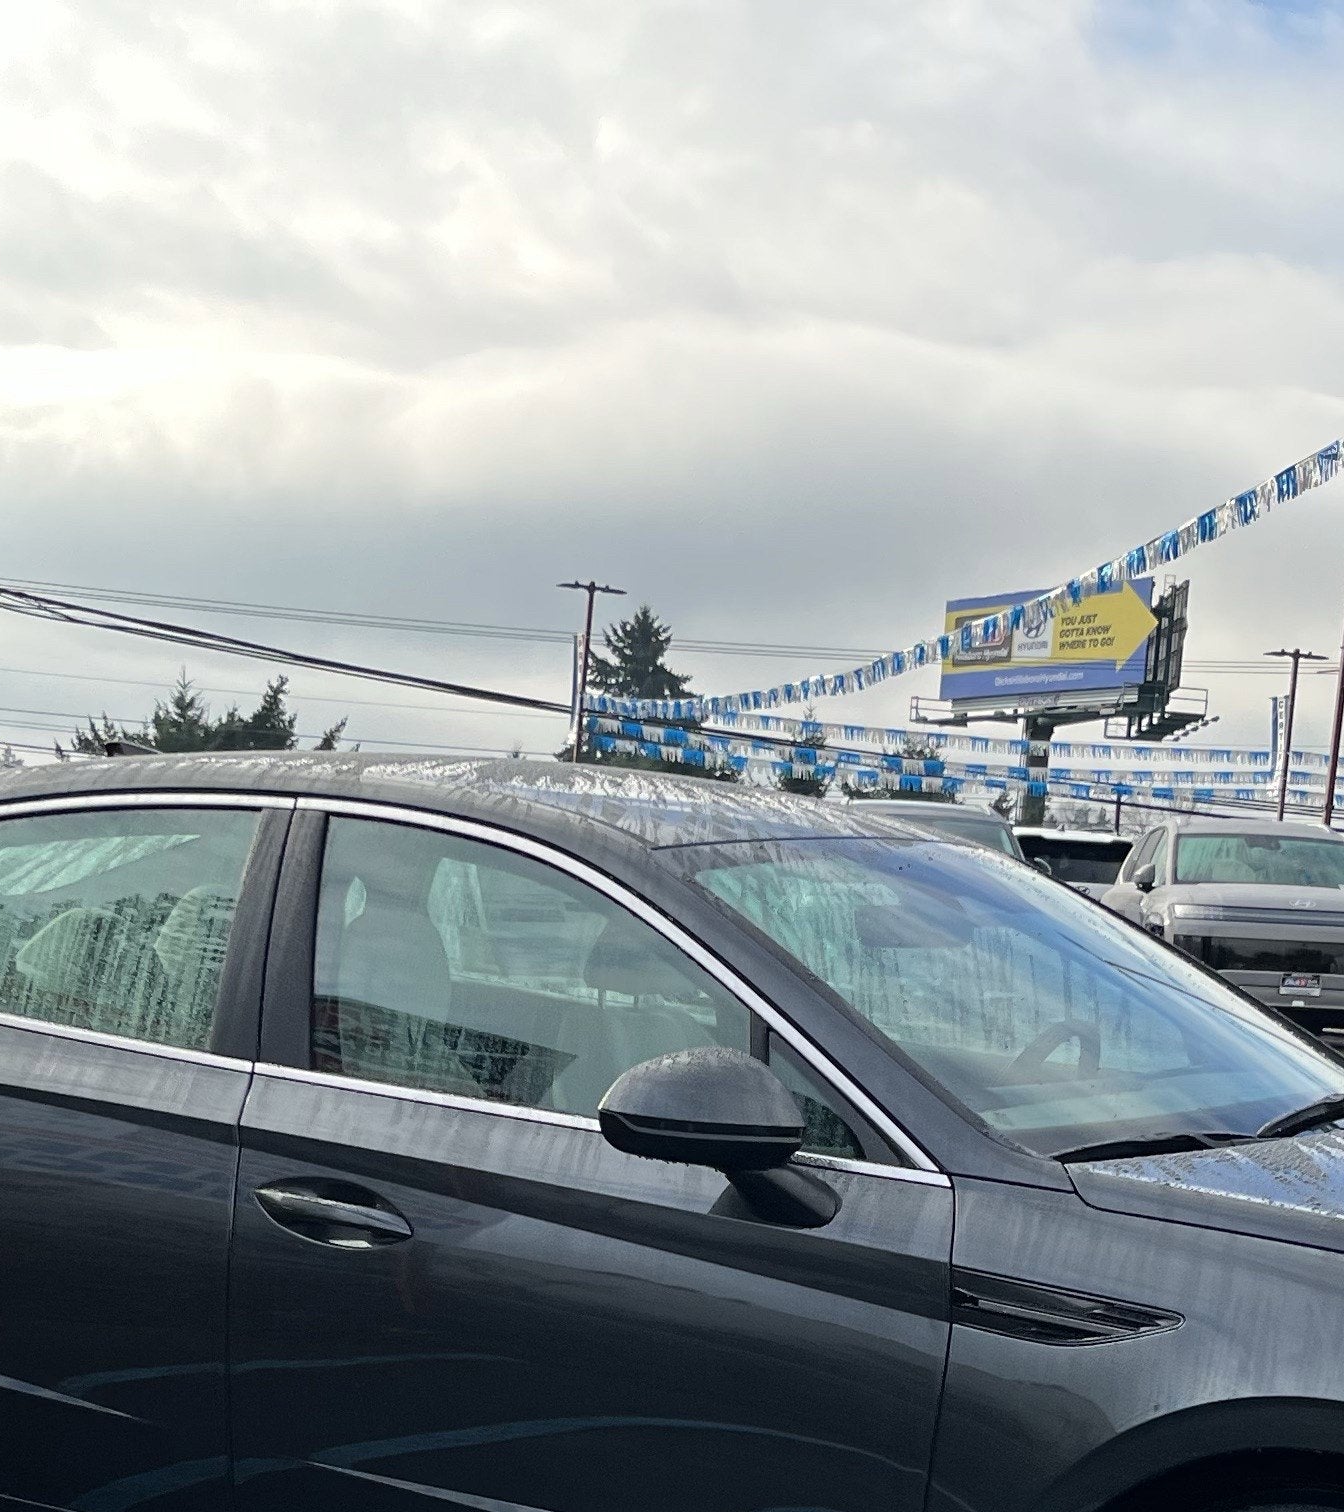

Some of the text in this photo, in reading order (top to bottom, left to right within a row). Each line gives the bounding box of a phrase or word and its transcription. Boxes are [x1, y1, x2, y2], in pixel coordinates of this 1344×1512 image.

[1061, 614, 1097, 626] YOU JUST
[1059, 625, 1112, 638] GOTTA KNOW
[1059, 640, 1087, 650] WHERE
[1089, 639, 1099, 648] TO
